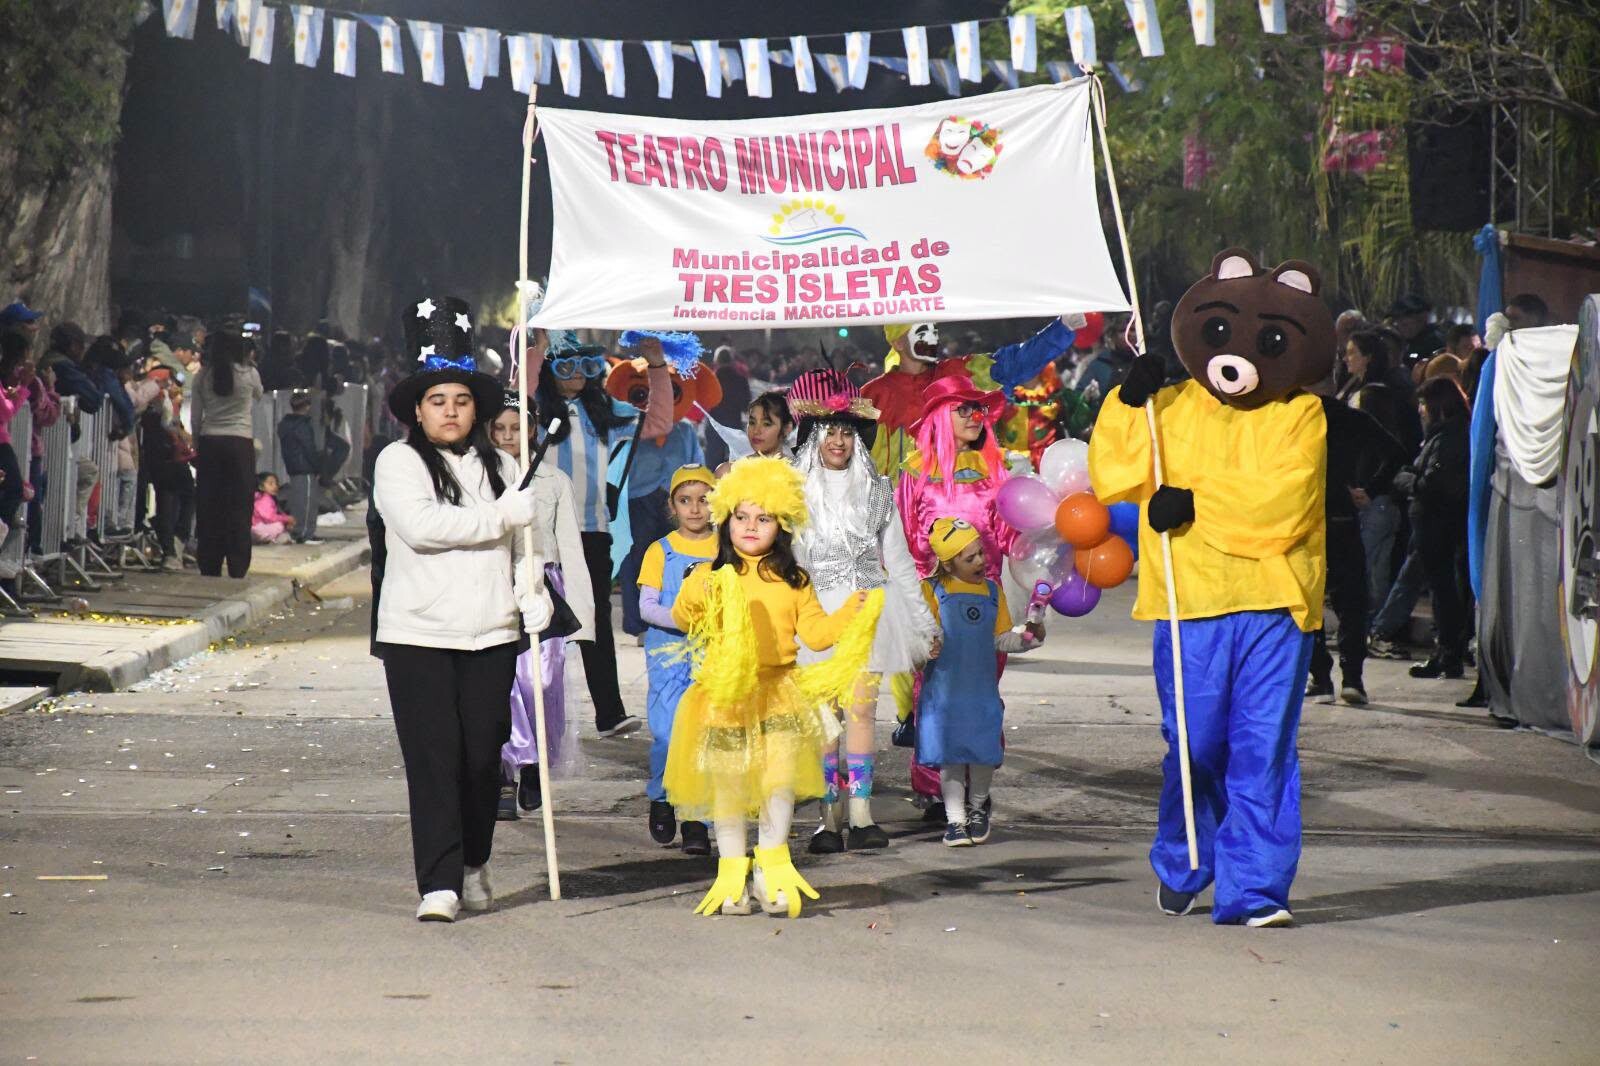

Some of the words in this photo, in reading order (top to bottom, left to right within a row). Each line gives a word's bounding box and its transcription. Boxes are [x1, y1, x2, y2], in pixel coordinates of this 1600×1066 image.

[595, 130, 728, 192] TEATRO
[734, 122, 917, 194] MUNICIPAL
[672, 241, 900, 274] Municipalidad
[911, 238, 950, 259] de
[679, 273, 779, 304] TRES
[786, 263, 942, 303] ISLETAS
[783, 303, 871, 320] MARCELA
[873, 296, 945, 316] DUARTE
